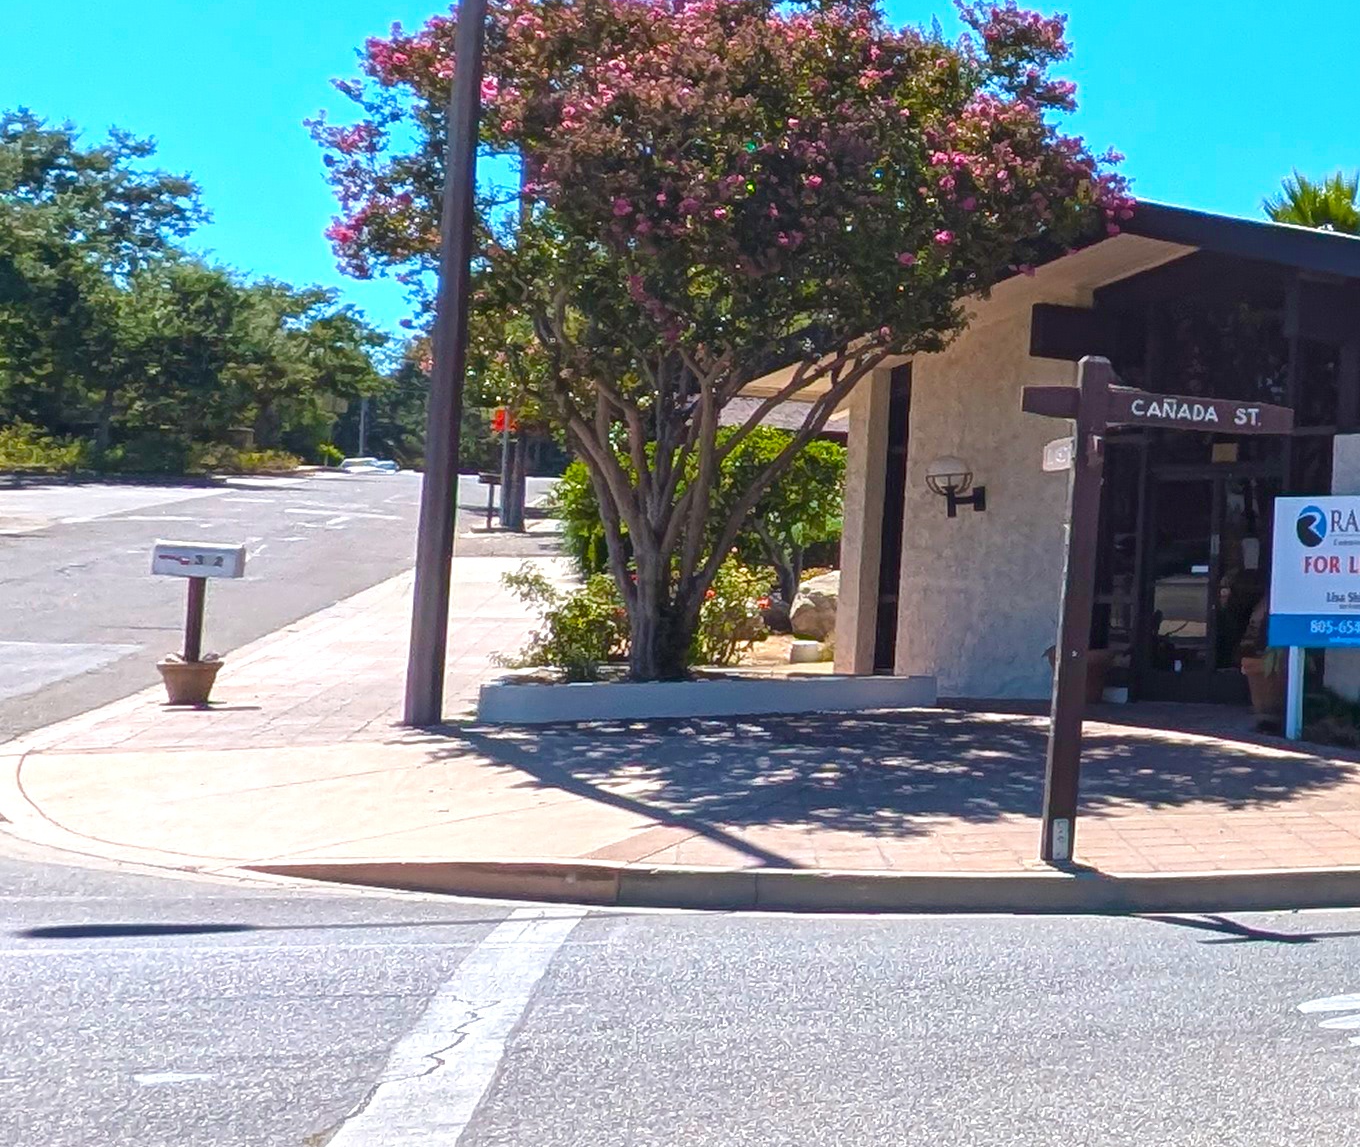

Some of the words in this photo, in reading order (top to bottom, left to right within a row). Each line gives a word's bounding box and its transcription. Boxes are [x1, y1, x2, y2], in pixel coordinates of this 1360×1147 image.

[1131, 398, 1219, 423] CAÑADA
[1233, 408, 1262, 427] ST.
[1304, 555, 1341, 574] FOR
